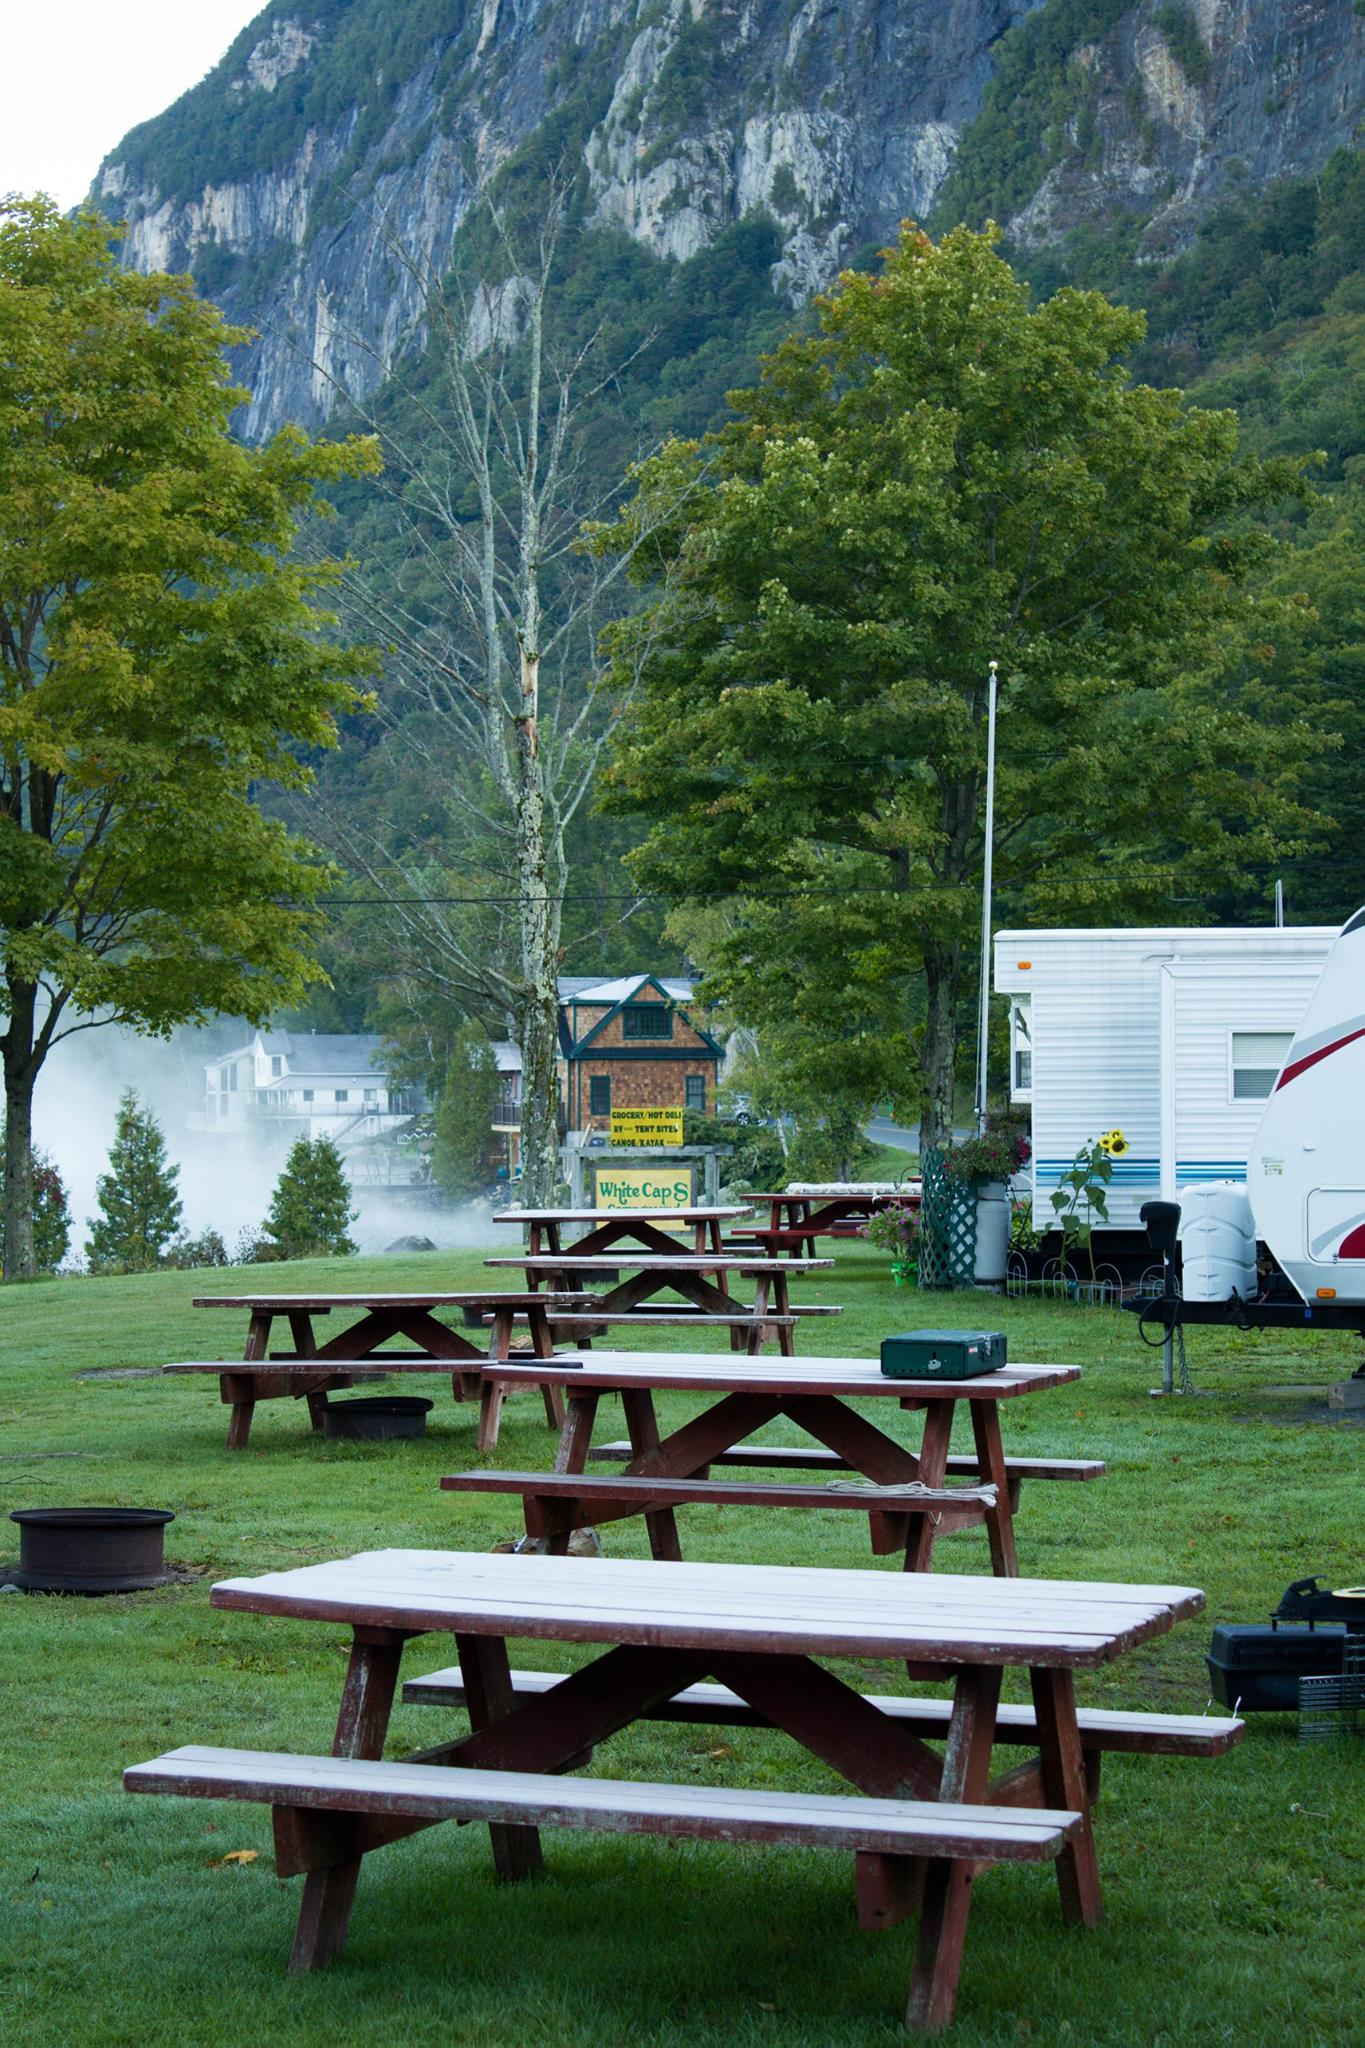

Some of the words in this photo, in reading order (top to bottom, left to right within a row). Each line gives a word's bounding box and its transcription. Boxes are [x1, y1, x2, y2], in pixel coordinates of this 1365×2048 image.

[614, 1125, 623, 1133] RV
[635, 1125, 654, 1133] TENT
[599, 1181, 640, 1205] White
